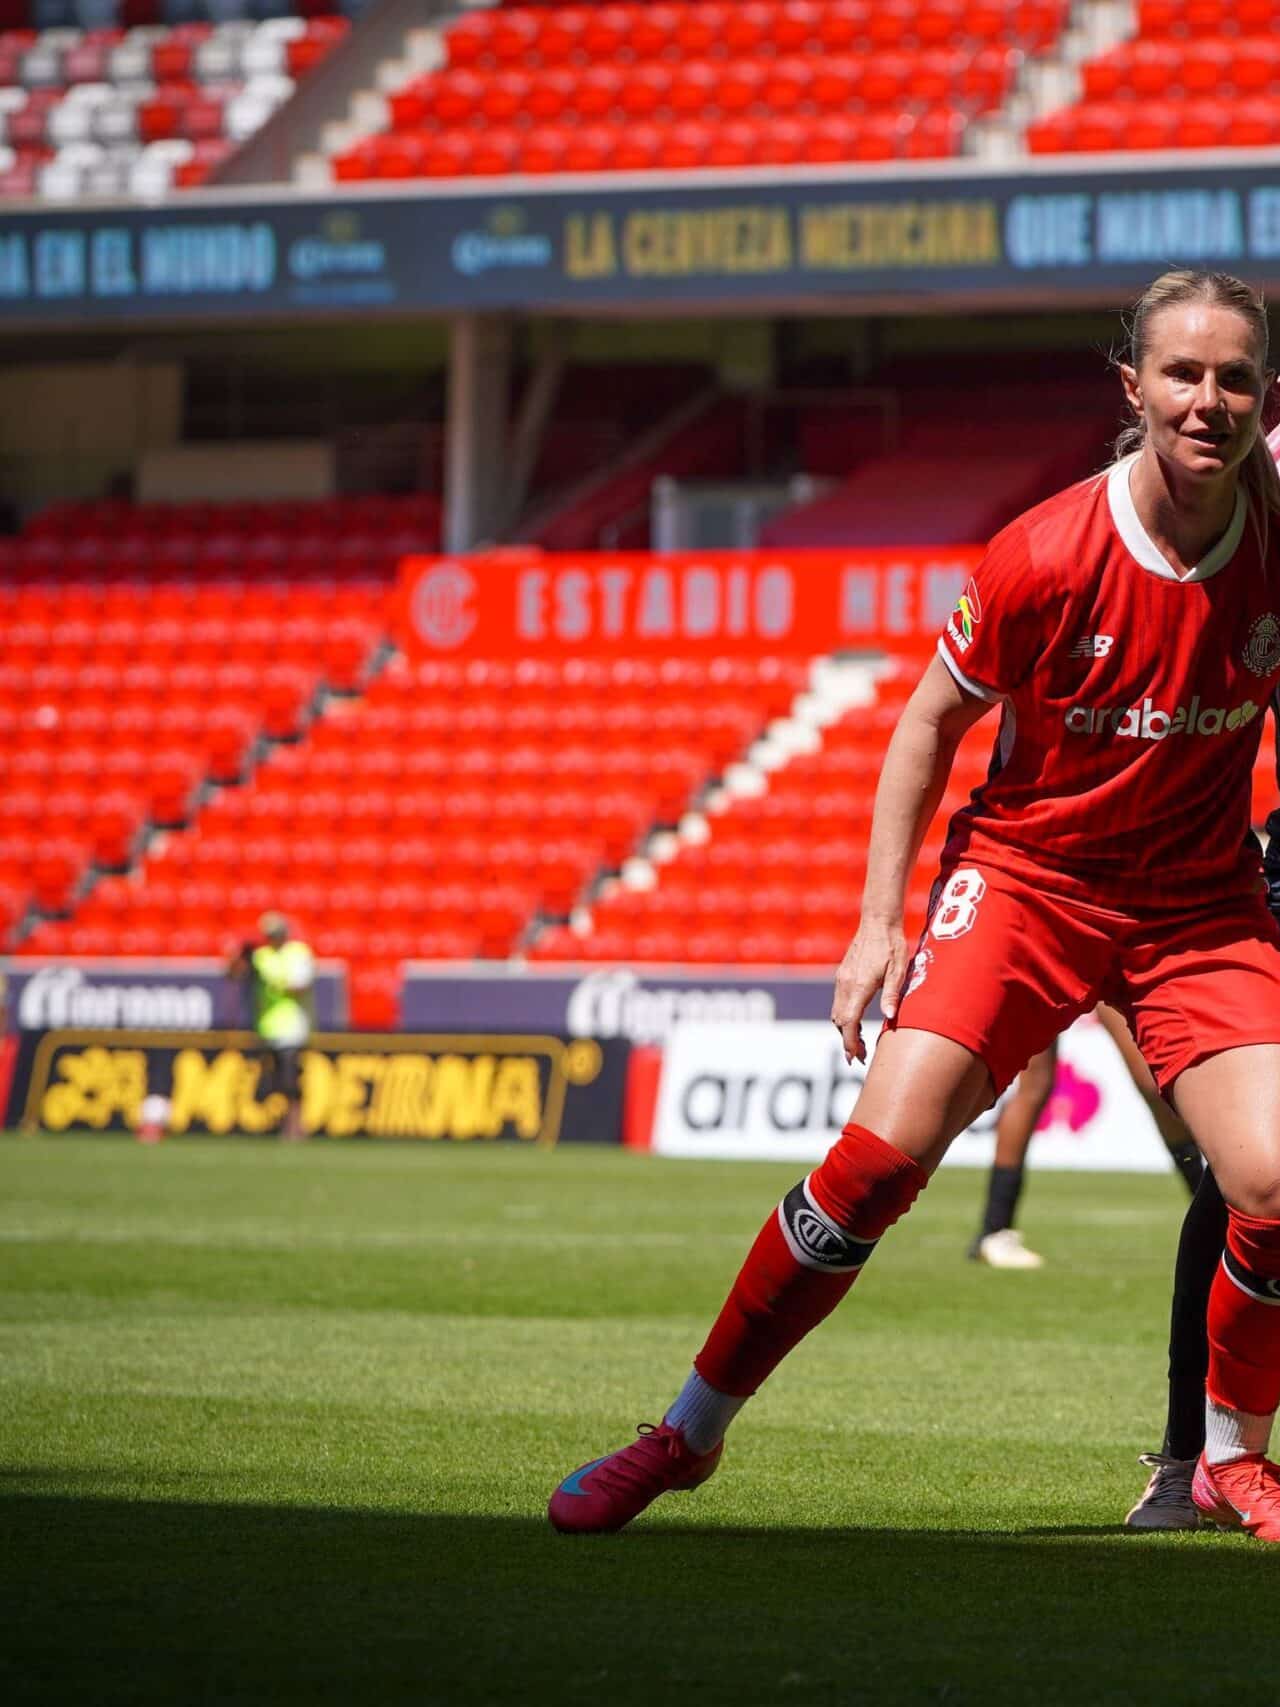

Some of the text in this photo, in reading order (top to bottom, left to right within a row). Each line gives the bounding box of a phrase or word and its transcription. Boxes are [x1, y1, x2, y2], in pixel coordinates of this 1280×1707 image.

[34, 229, 86, 298] EN
[91, 226, 136, 297] EL
[140, 221, 277, 295] MUNDO
[565, 210, 617, 278] LA
[623, 207, 790, 277] CERVEZA
[800, 199, 998, 268] MEXICANA
[1005, 193, 1092, 269] QUE
[1097, 189, 1244, 263] MANDA
[515, 566, 797, 642] ESTADIO
[1064, 695, 1226, 740] arabela
[930, 867, 987, 940] 8
